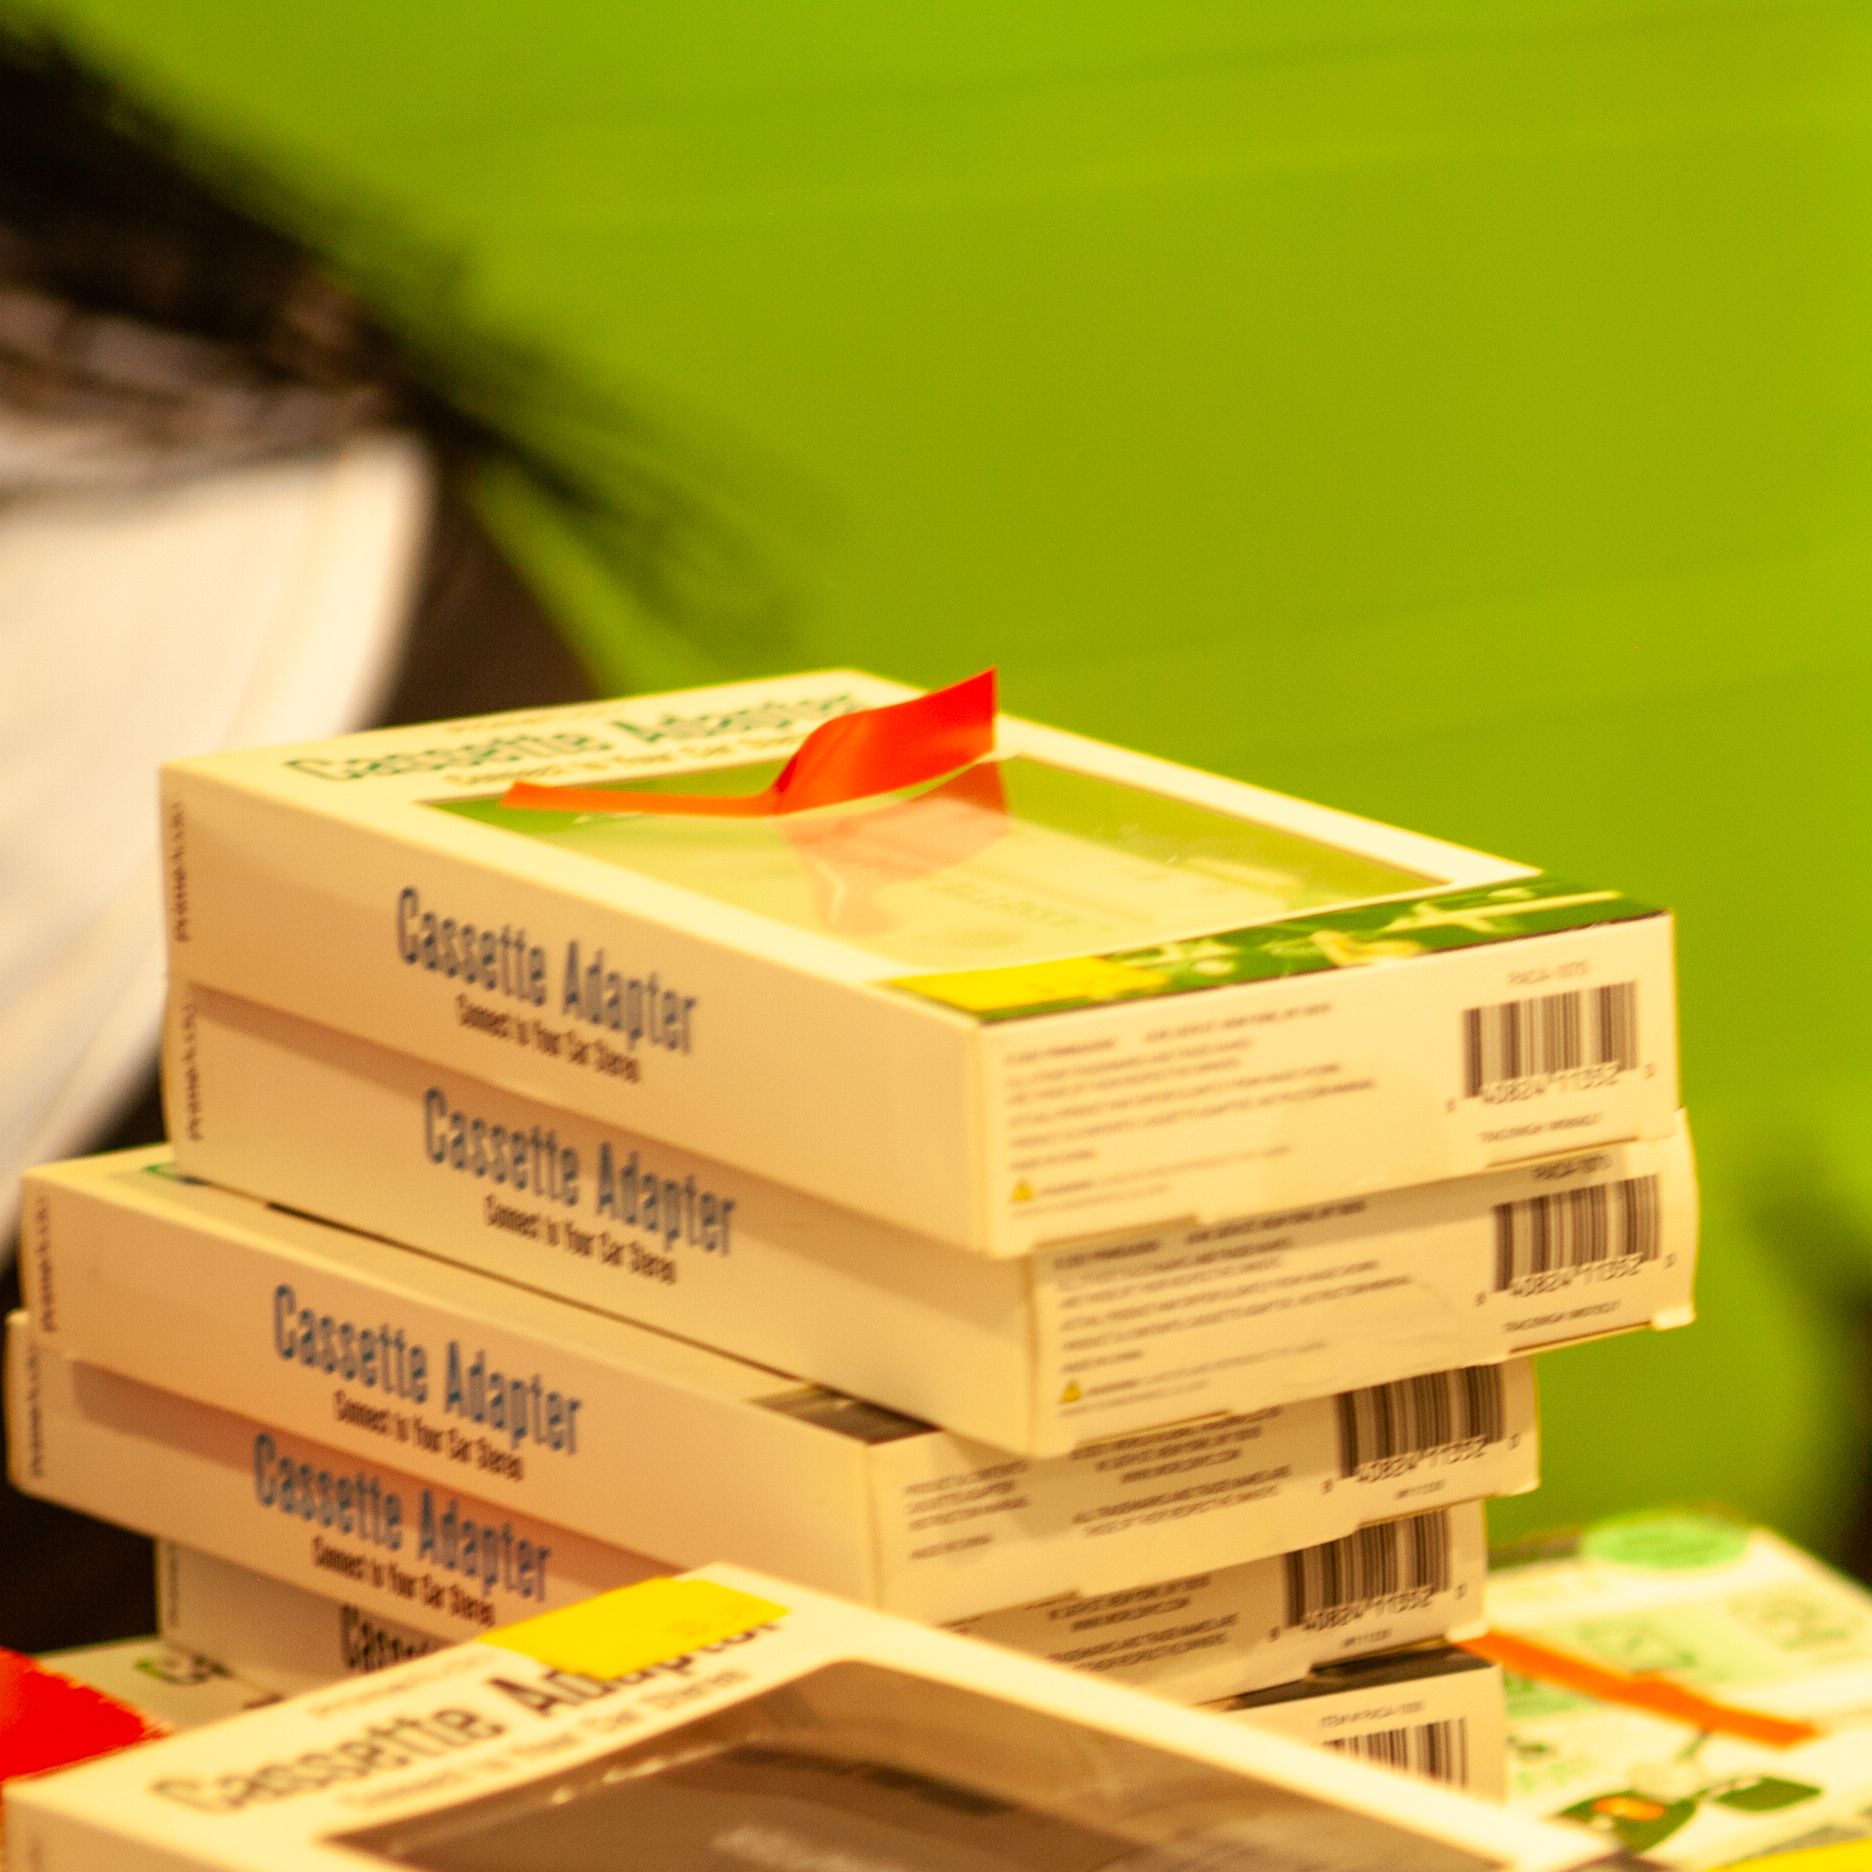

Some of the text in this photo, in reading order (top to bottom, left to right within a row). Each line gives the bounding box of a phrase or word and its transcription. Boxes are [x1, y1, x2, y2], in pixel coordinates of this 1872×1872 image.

[397, 886, 698, 1056] Cassette Adapter
[424, 1087, 737, 1258] Cassette Adapter
[273, 1283, 581, 1457] Cassette Adapter
[255, 1433, 551, 1603] Cassette Adapter
[152, 1706, 505, 1811] Cassette
